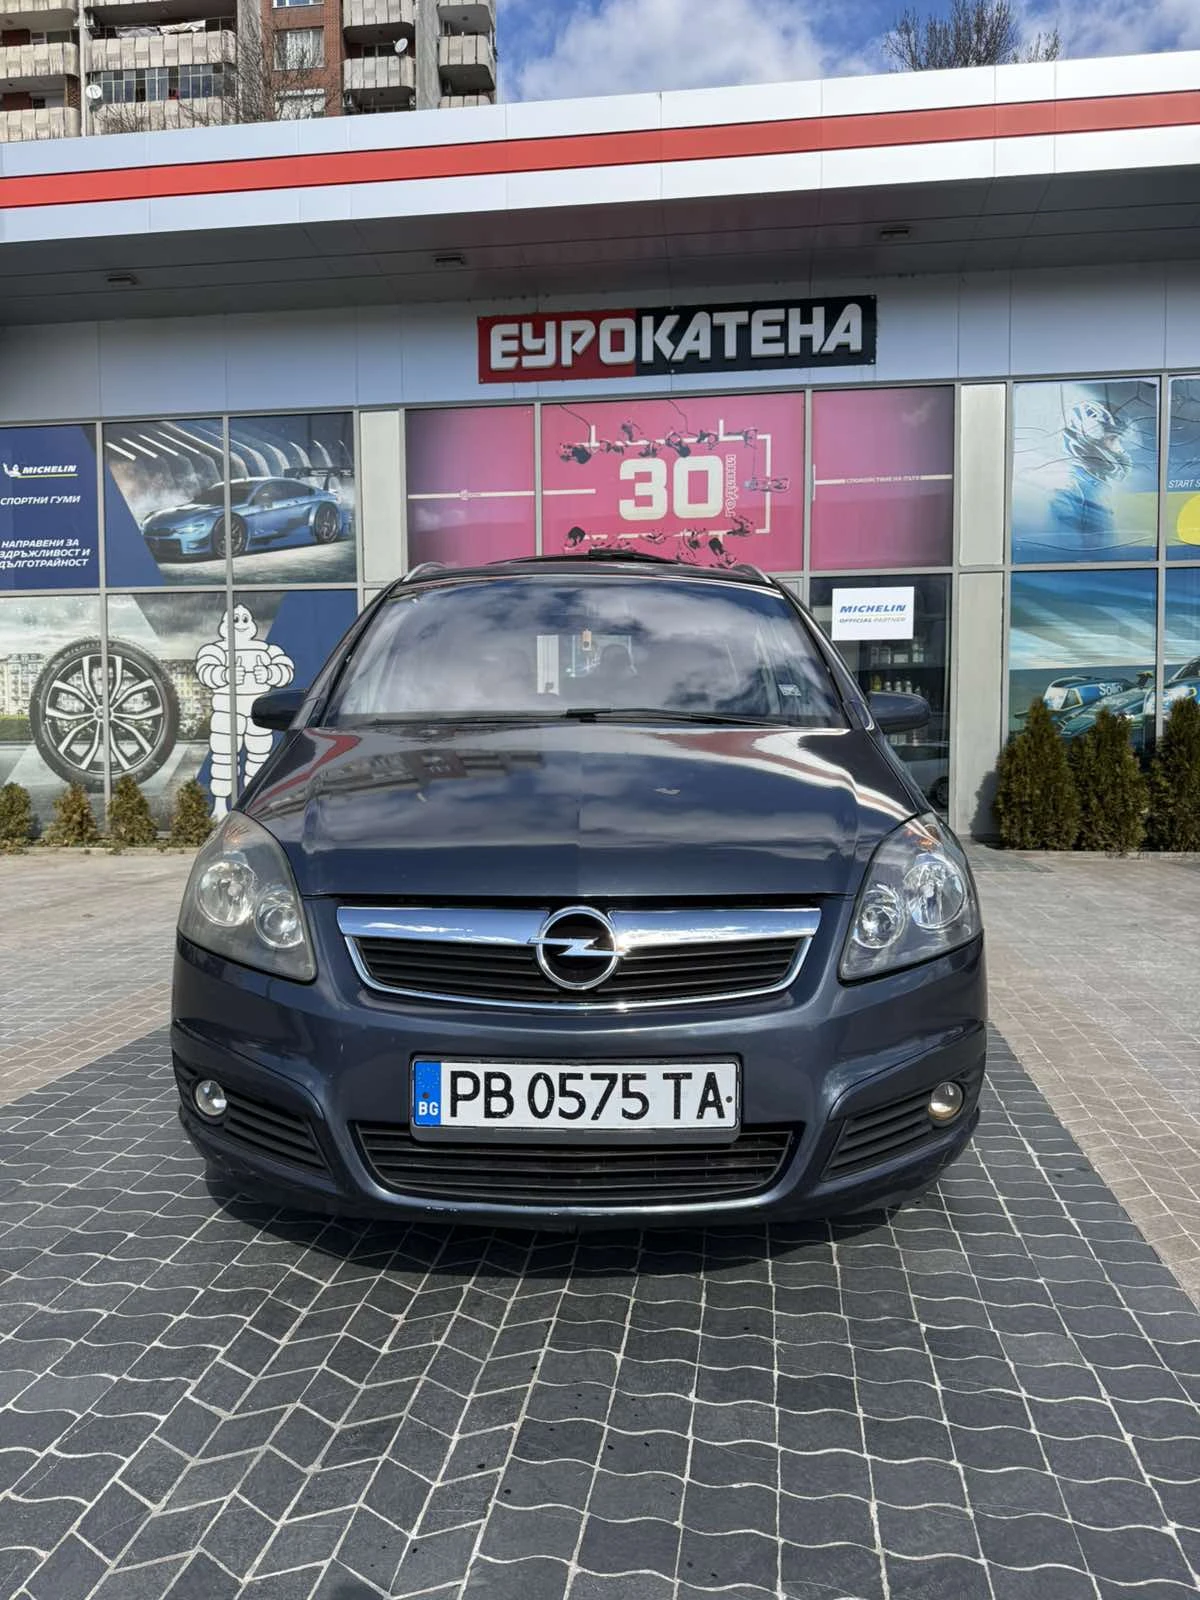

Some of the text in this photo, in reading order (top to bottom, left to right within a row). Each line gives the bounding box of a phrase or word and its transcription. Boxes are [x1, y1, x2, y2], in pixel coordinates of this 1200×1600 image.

[489, 303, 863, 371] ЕУРОКАТЕНА
[22, 465, 77, 474] MICHELIN
[619, 455, 724, 521] 30
[1168, 479, 1194, 489] START
[0, 495, 81, 506] СПОРТНИ ГУМИ
[1, 538, 79, 548] НАПРАВЕНИ ЗА
[81, 548, 91, 557] И
[840, 604, 906, 613] MICHELIN
[418, 1070, 725, 1121] BG PB 0575 TA
